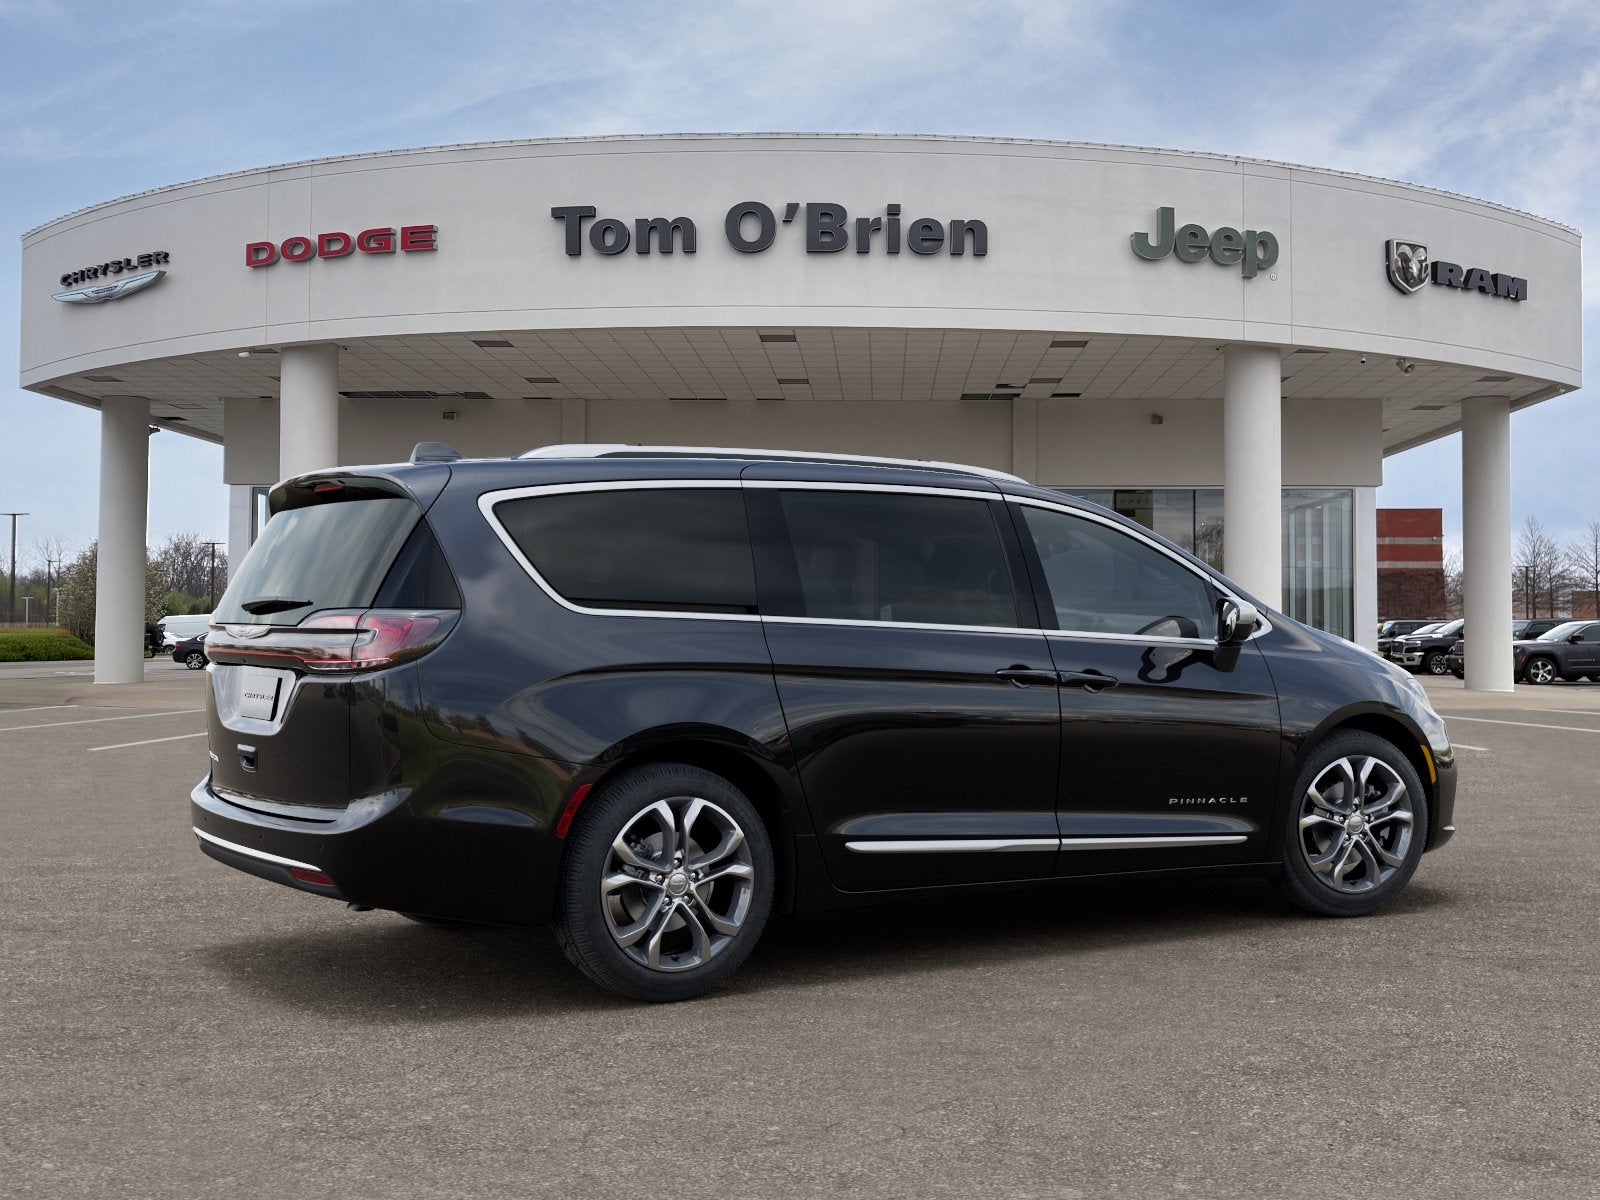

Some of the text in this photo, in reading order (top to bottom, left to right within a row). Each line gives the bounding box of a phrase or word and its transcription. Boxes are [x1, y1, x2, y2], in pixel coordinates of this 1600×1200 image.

[245, 224, 438, 268] DODGE
[550, 201, 989, 257] Tom O'Brien
[1130, 206, 1280, 279] Jeep
[60, 250, 170, 287] CHRYSLER
[1430, 260, 1528, 301] RAM
[1168, 797, 1249, 805] PINNACLE
